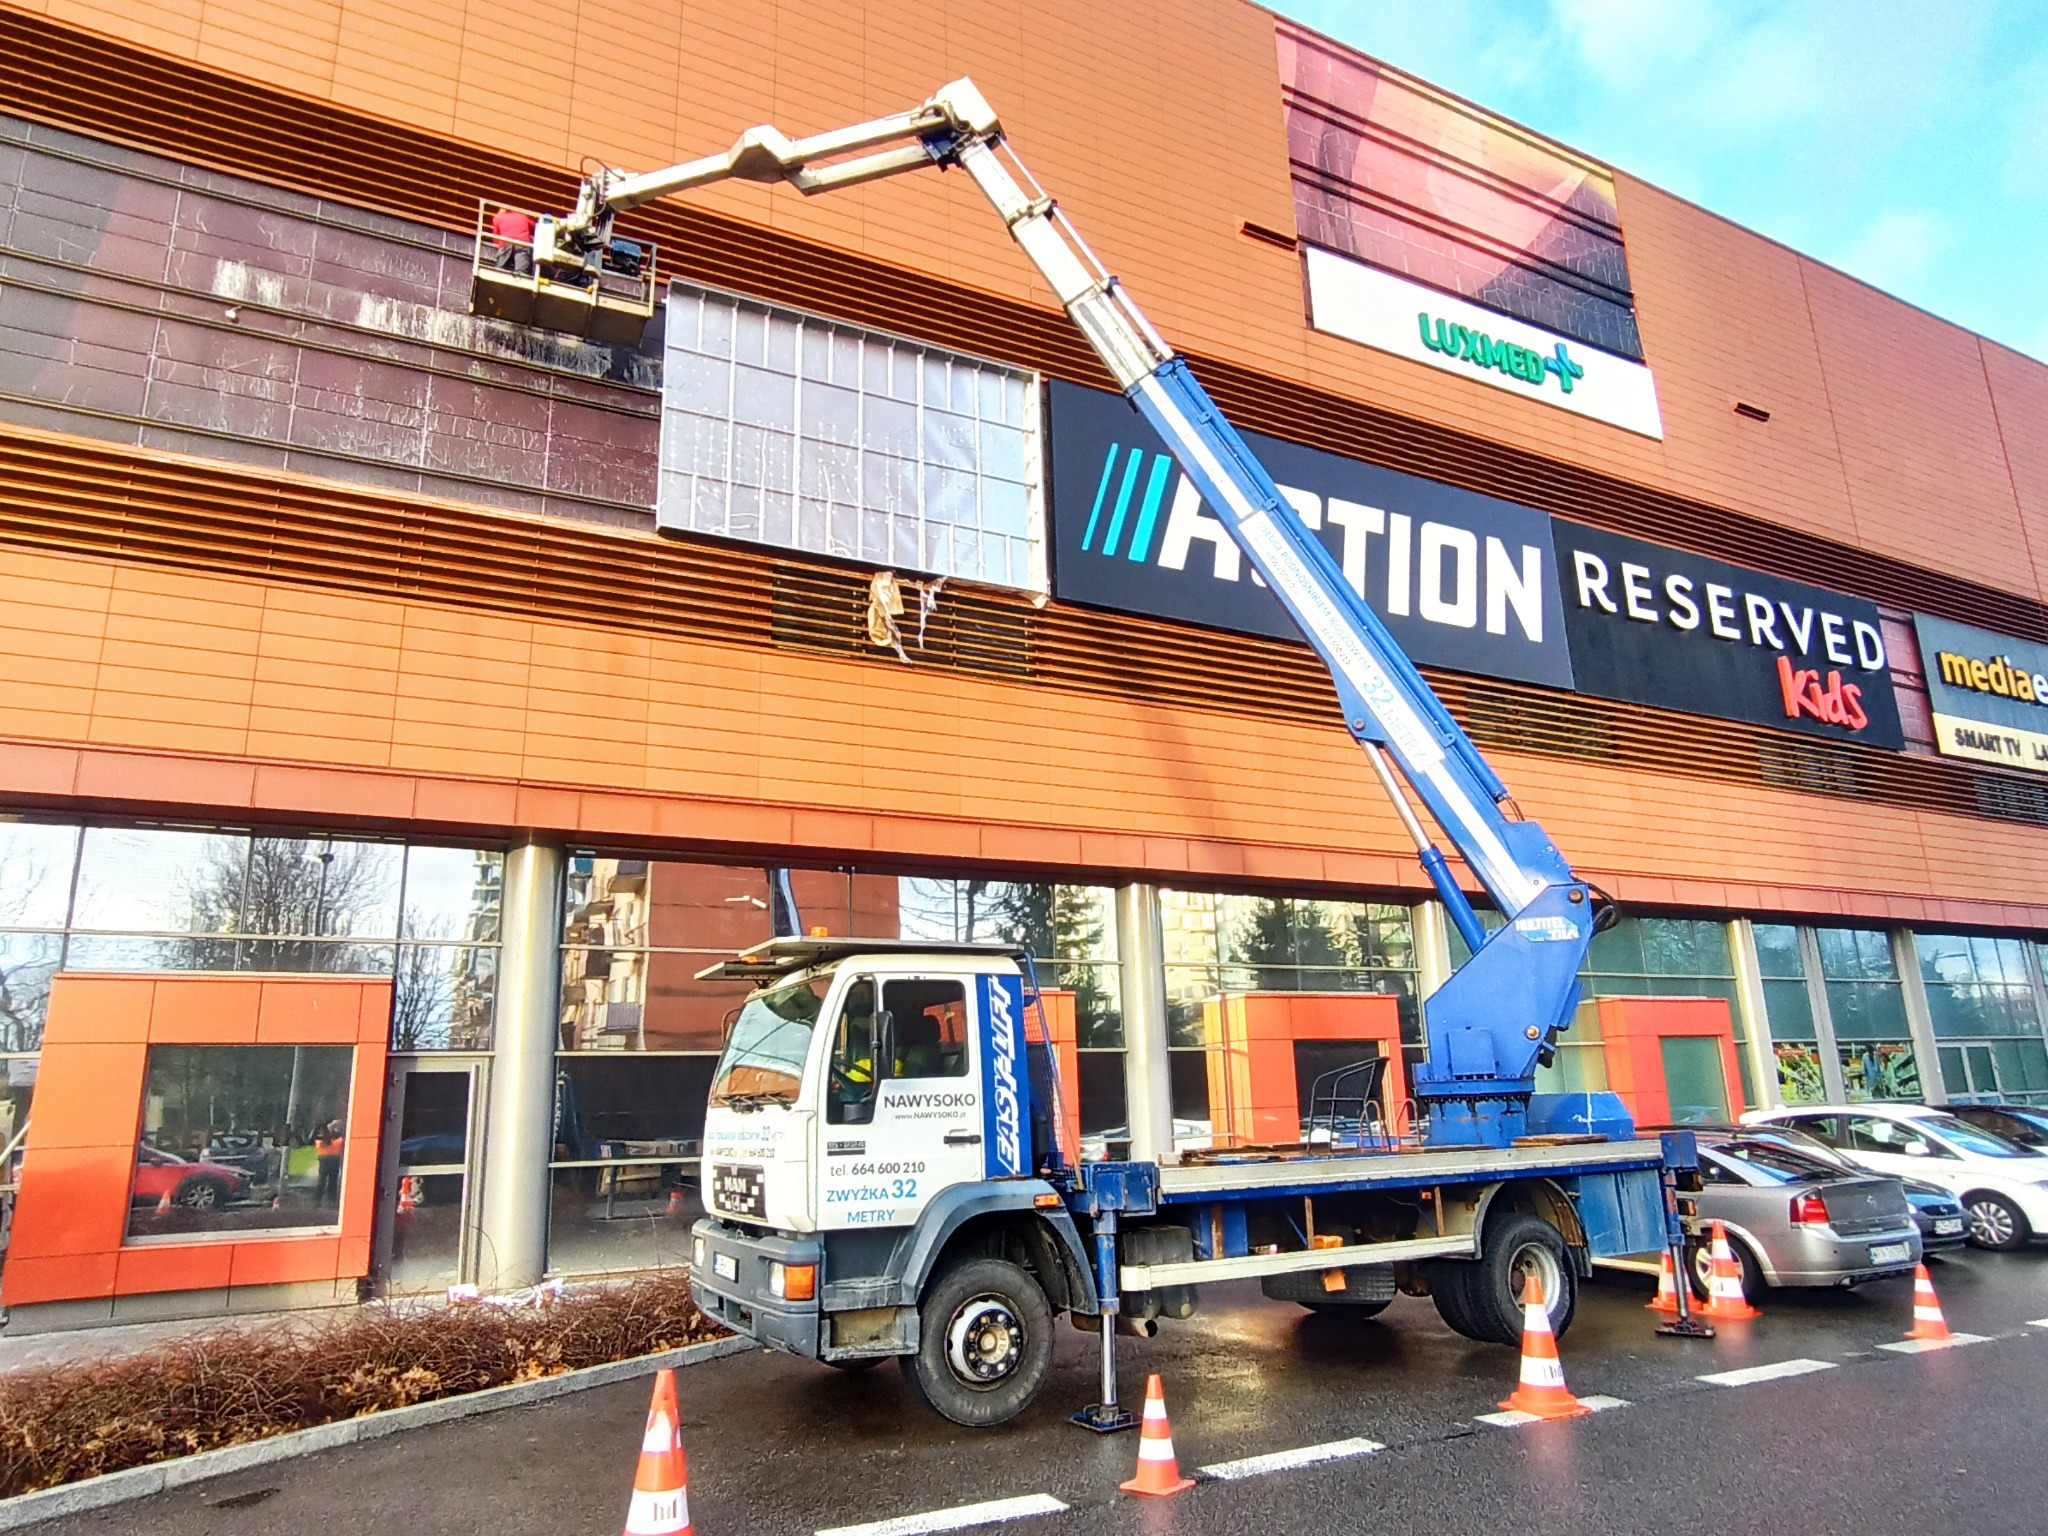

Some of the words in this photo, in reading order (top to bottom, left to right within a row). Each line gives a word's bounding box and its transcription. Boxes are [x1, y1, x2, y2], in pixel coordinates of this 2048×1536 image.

[1418, 313, 1545, 385] LUXMED
[1572, 550, 1885, 672] RESERVED
[1359, 672, 1396, 710] 32
[1380, 706, 1429, 763] METRY
[1955, 727, 2002, 754] SMART
[2003, 736, 2021, 757] TV
[884, 1093, 976, 1109] NAWYSOKO
[830, 1164, 849, 1176] tel.
[851, 1163, 875, 1175] 664
[877, 1162, 900, 1174] 600
[903, 1161, 925, 1173] 210
[724, 1176, 747, 1193] MAN
[826, 1185, 889, 1202] ZWYŻKA
[891, 1178, 917, 1198] 32
[847, 1209, 896, 1223] METRY
